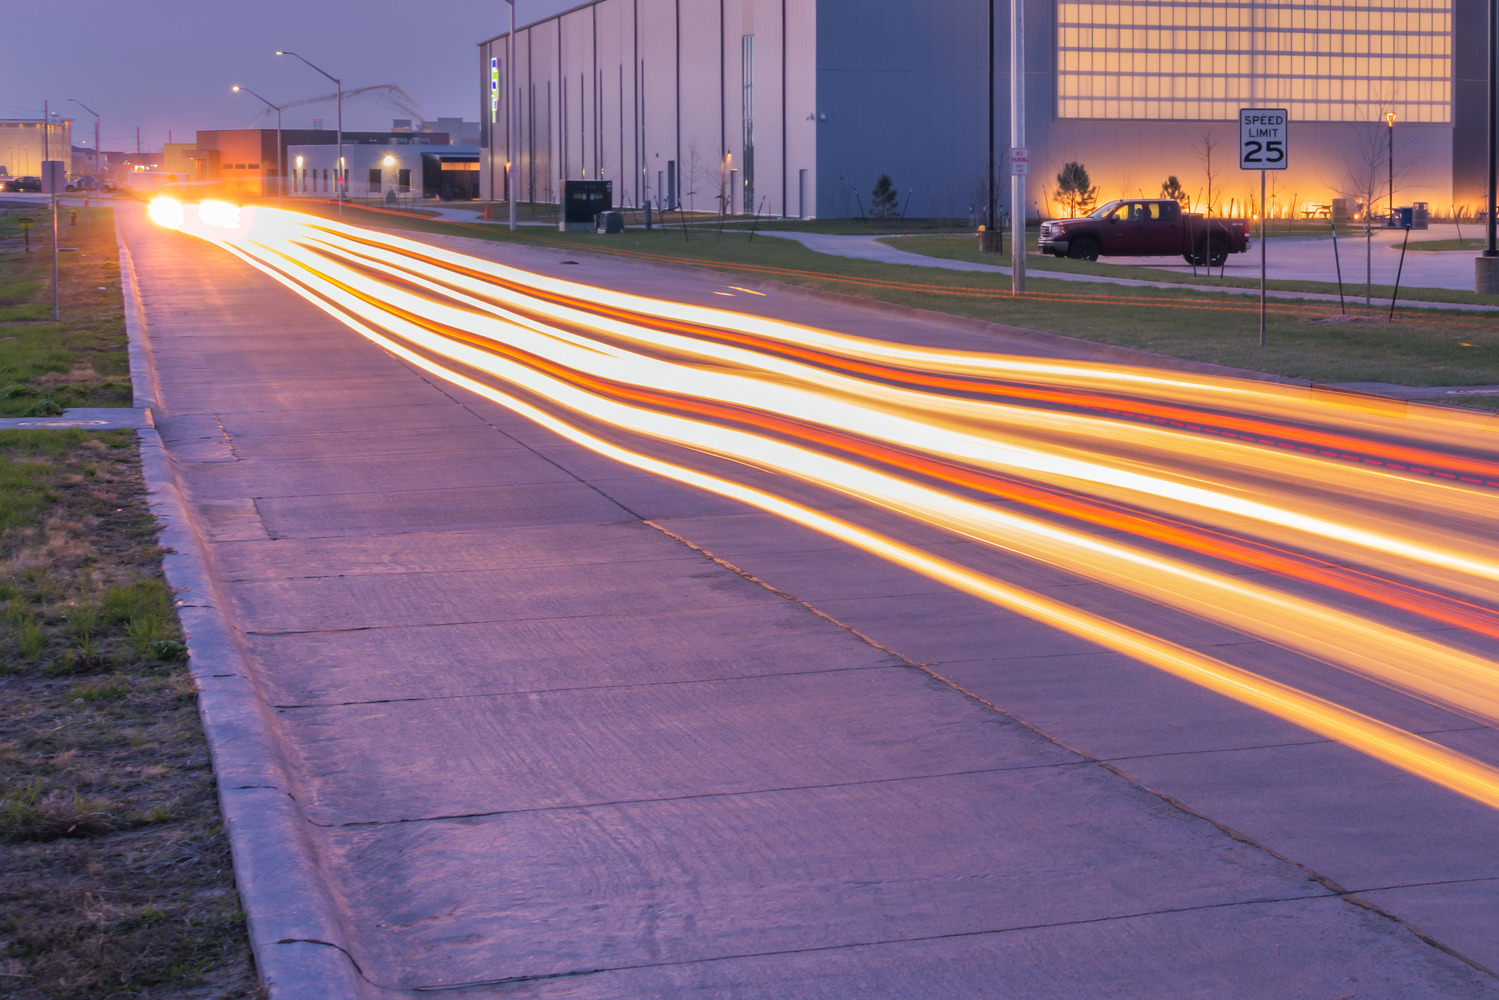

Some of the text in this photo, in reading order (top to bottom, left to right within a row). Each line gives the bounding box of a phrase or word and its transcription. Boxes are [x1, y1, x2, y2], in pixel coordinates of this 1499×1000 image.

[1244, 116, 1283, 125] SPEED
[1248, 128, 1278, 138] LIMIT
[1243, 141, 1284, 162] 25
